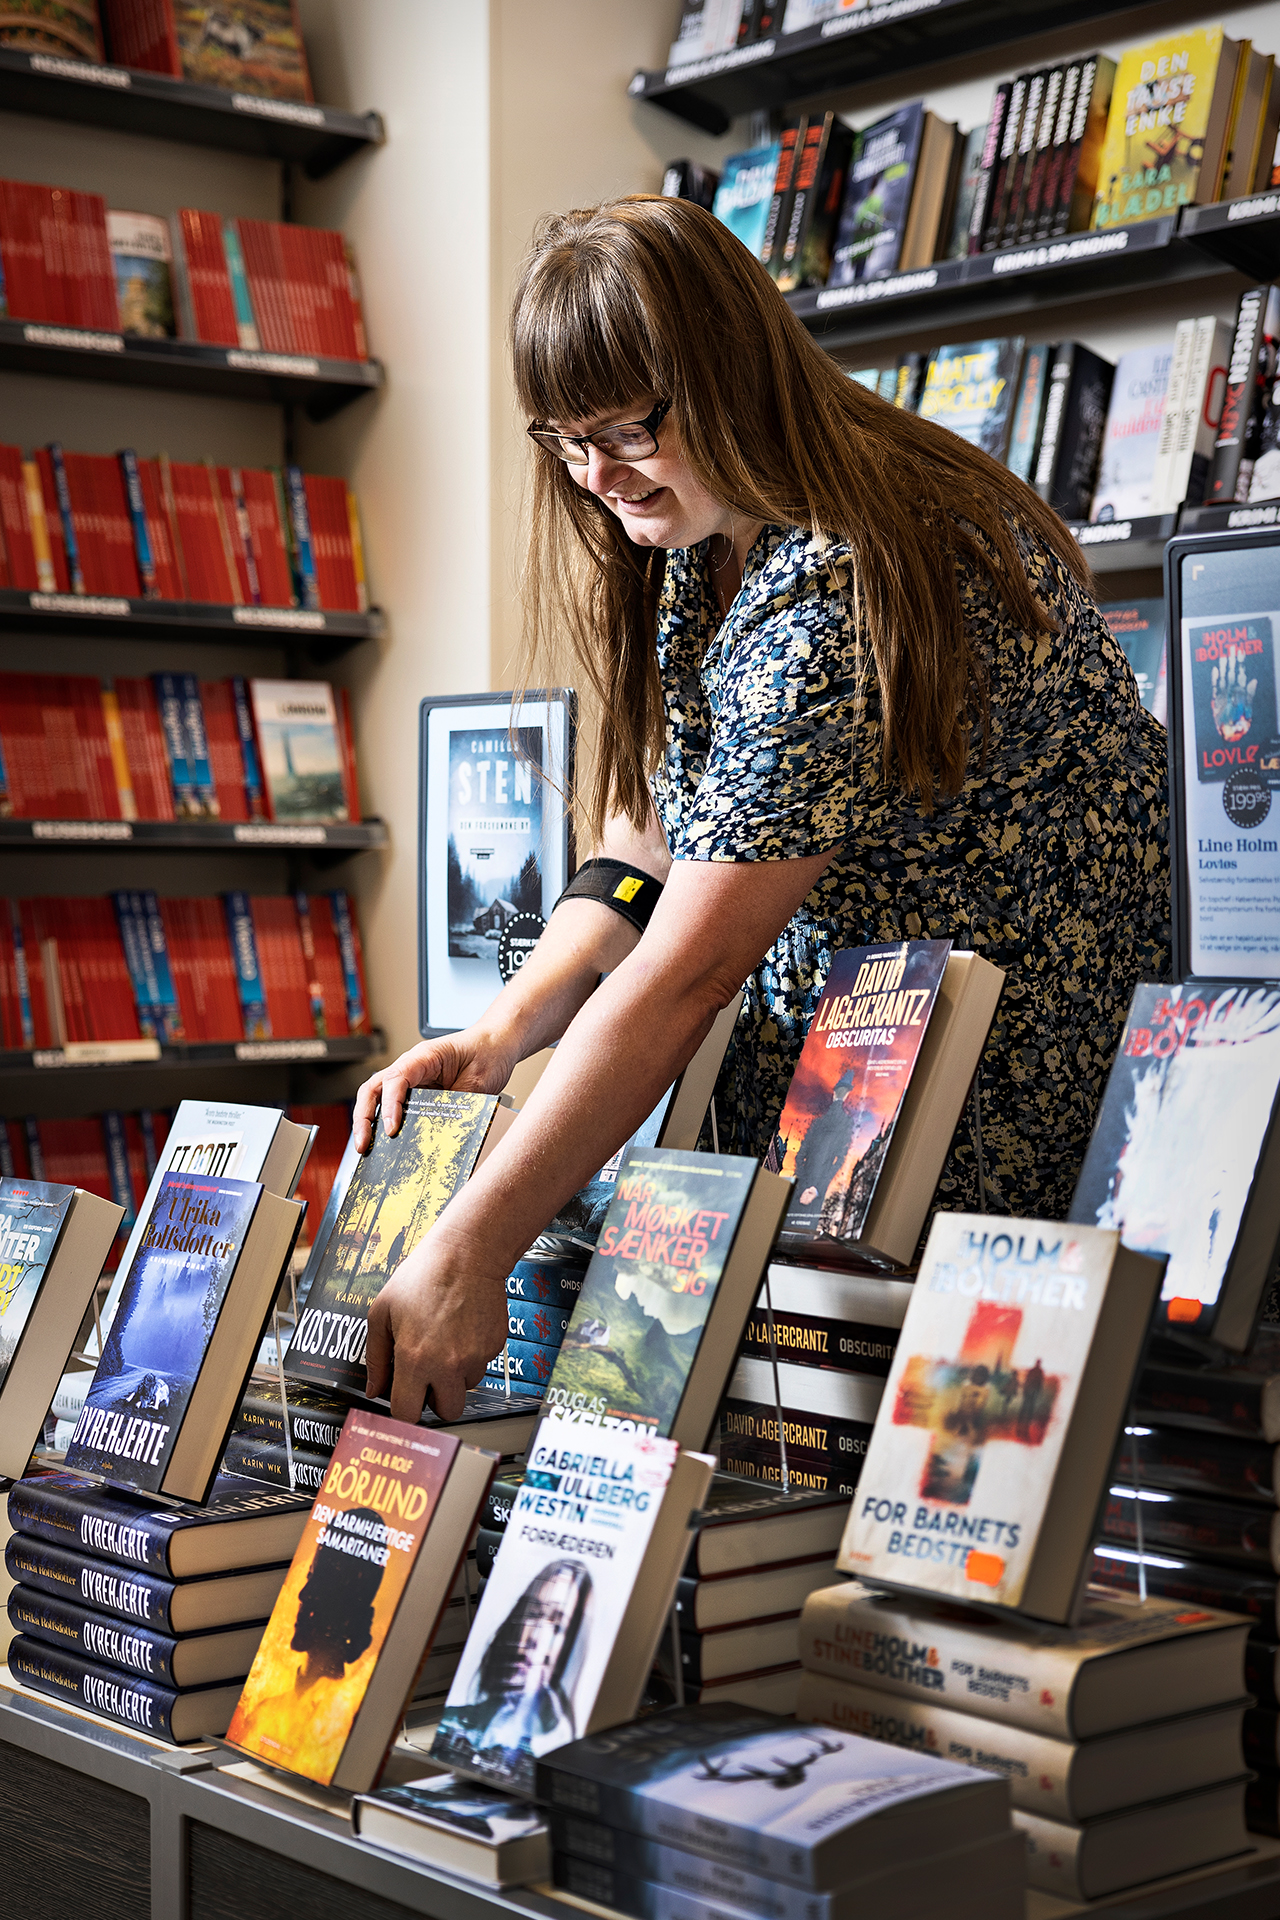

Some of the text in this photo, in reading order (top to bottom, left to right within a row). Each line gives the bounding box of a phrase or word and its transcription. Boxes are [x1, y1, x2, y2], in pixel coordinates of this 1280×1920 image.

[1140, 50, 1188, 81] DEN
[1124, 101, 1185, 137] ENKE
[1120, 164, 1171, 194] SARA
[1195, 639, 1264, 662] BOLTHER
[1203, 627, 1248, 646] HOLM
[458, 758, 533, 806] STEN
[1198, 838, 1279, 853] Line Holm
[1199, 858, 1238, 871] Lovløs
[851, 959, 907, 998] DAVID
[815, 989, 932, 1032] LAGERCRANTZ
[825, 1027, 897, 1049] OBSCURITAS
[617, 1173, 656, 1204] NÅR
[168, 1196, 221, 1231] Ulrika
[623, 1200, 729, 1241] MØRKET
[140, 1223, 236, 1259] Rolfsdotter
[599, 1226, 709, 1269] SÆNKER
[964, 1229, 1062, 1266] HOLM
[335, 1290, 363, 1305] KARIN
[672, 1269, 709, 1297] SIG
[756, 1322, 829, 1353] LAGERCRANTZ
[546, 1386, 607, 1416] DOUGLAS
[71, 1405, 171, 1467] DYREHJERTE
[243, 1412, 265, 1426] KARIN
[268, 1416, 283, 1431] WIK
[726, 1411, 755, 1437] DAVID
[756, 1418, 828, 1451] LAGERCRANTZ
[242, 1456, 264, 1470] KARIN
[267, 1461, 282, 1475] WIK
[533, 1446, 635, 1483] GABRIELLA
[325, 1456, 429, 1522] BÖRJLIND
[562, 1475, 651, 1513] ULLBERG
[519, 1491, 588, 1524] WESTIN
[862, 1497, 1022, 1548] FOR BARNETS
[81, 1514, 150, 1564] DYREHJERTE
[312, 1503, 415, 1552] DEN BARMHJERTIGE
[520, 1524, 617, 1561] FORRÆDEREN
[315, 1527, 391, 1568] SAMARITANER
[15, 1557, 151, 1620] Ulrika Rolfsdotter DYREHJERTE
[17, 1610, 154, 1674] Ulrika Rolfsdotter DYREHJERTE
[951, 1658, 975, 1677] FOR
[17, 1660, 154, 1730] Ulrika Rolfsdotter DYREHJERTE
